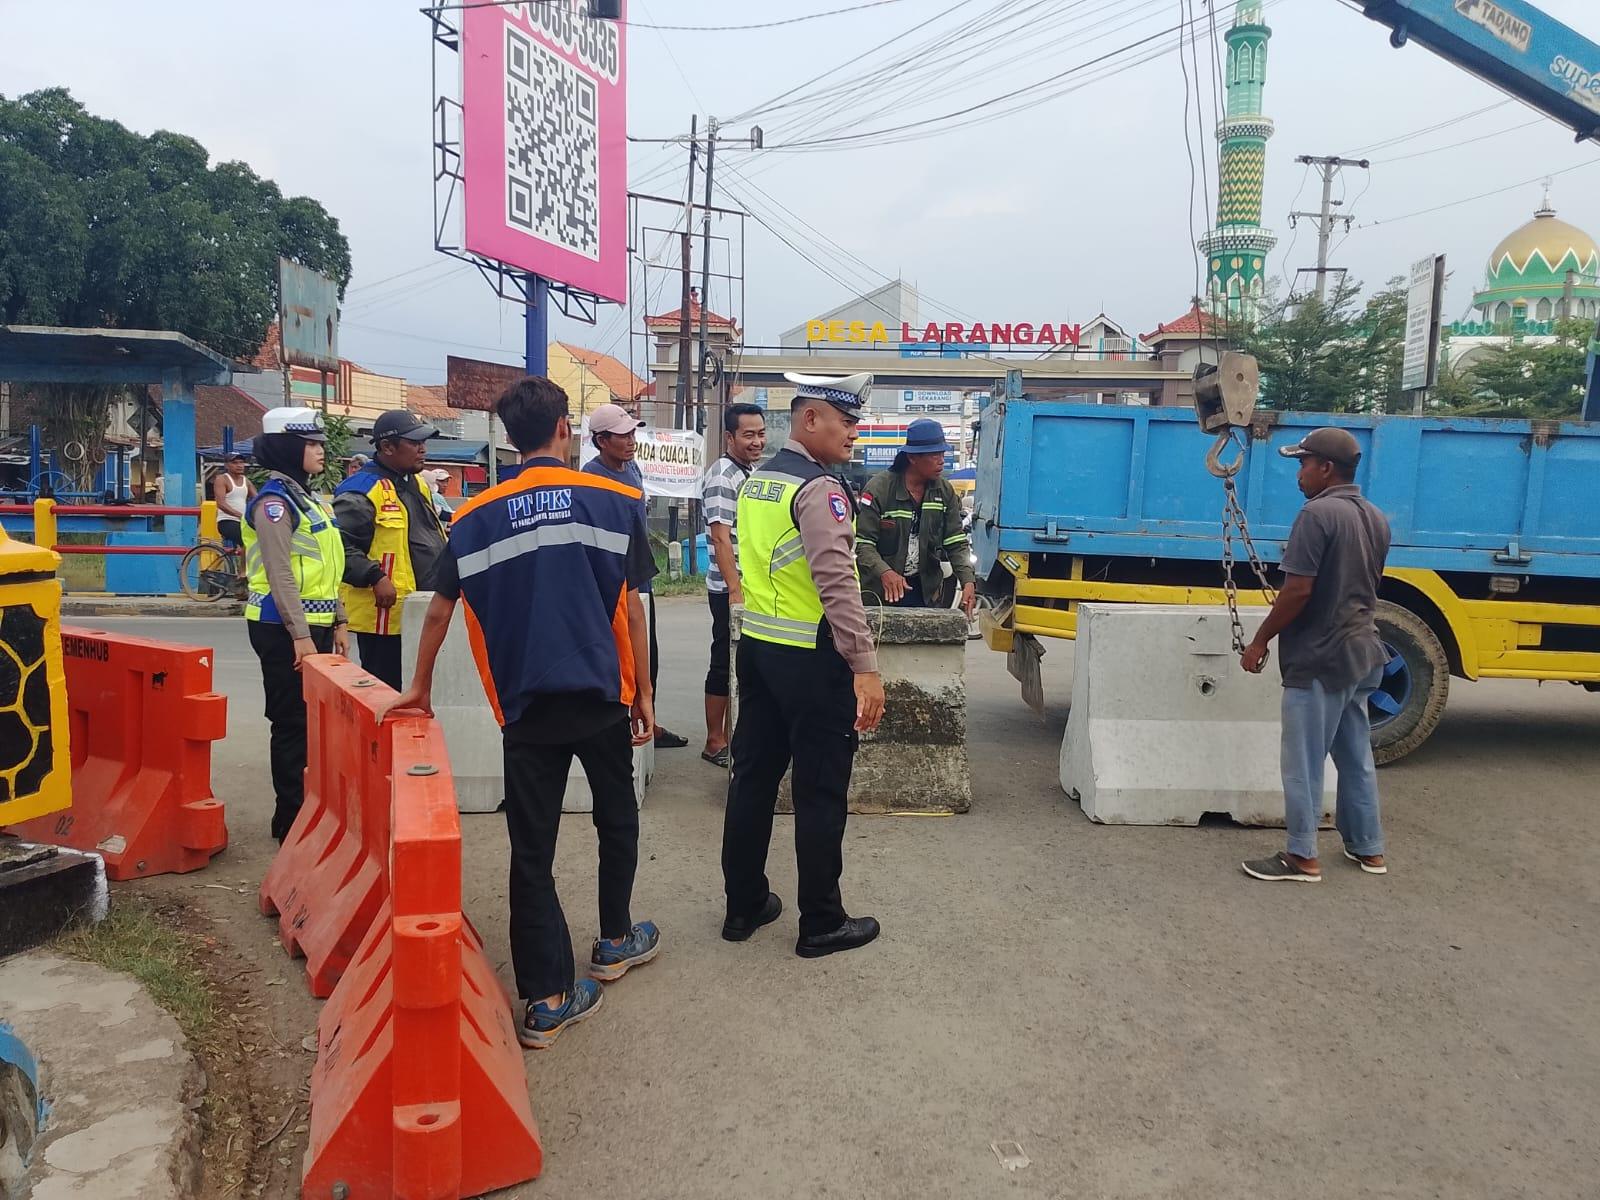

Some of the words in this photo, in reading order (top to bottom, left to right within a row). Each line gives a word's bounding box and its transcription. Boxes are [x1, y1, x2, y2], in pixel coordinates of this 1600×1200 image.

[1481, 2, 1529, 43] TADANO
[807, 320, 889, 343] DESA
[901, 322, 1080, 345] LARANGAN
[659, 444, 690, 465] CUACA
[507, 494, 533, 520] PT
[536, 488, 572, 512] PKS
[743, 480, 786, 503] POLISI
[63, 637, 110, 662] EMENHUB
